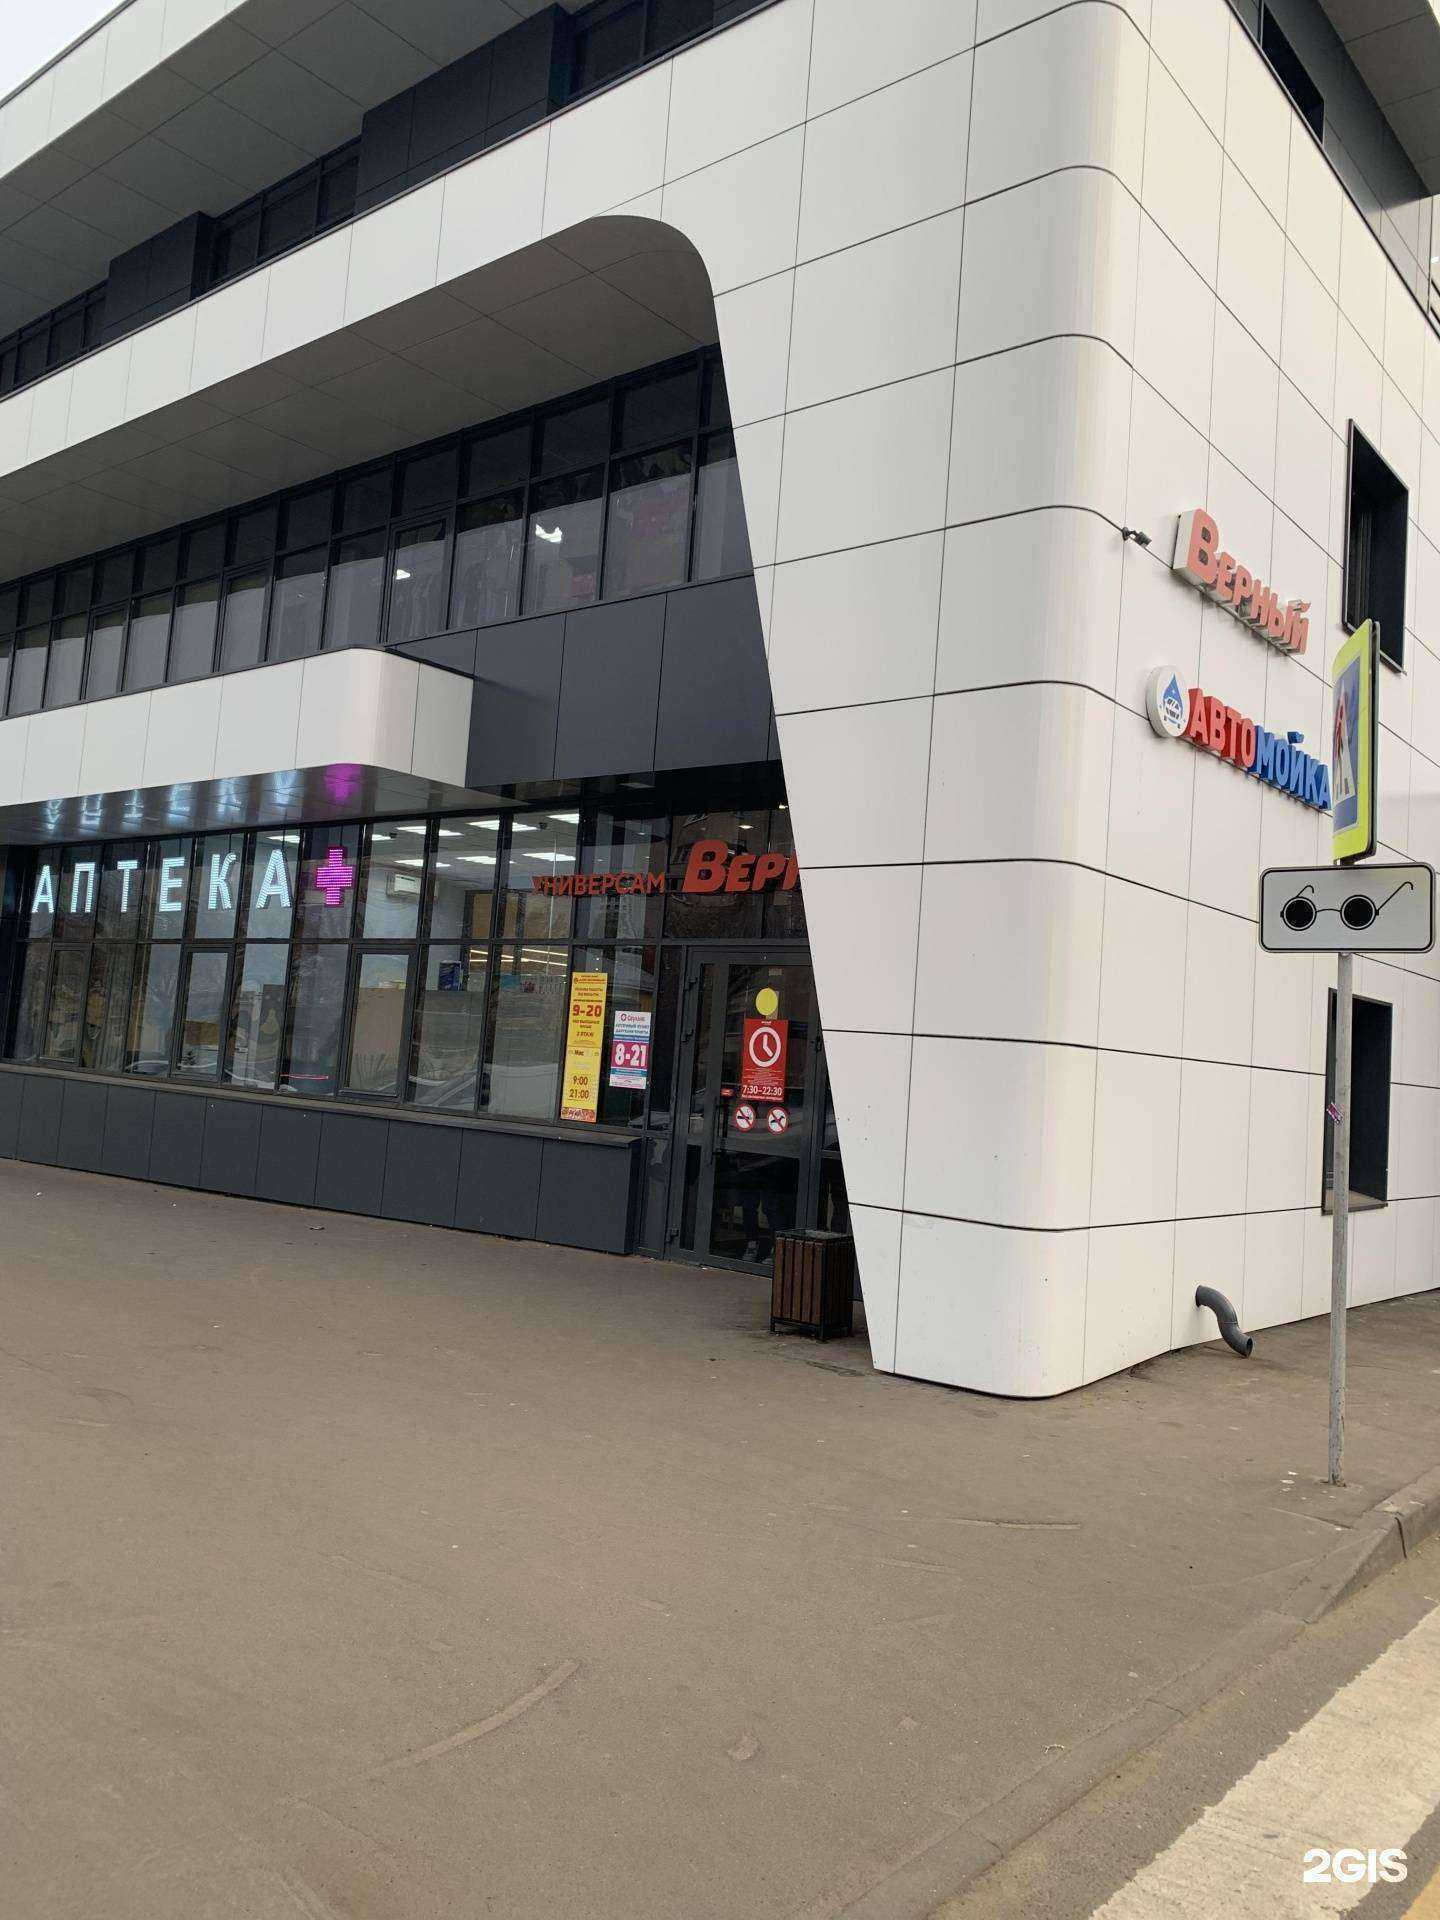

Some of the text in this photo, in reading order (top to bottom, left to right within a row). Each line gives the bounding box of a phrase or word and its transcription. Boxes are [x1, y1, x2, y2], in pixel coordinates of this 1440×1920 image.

[1187, 687, 1333, 811] АВТОМОЙКА
[31, 849, 291, 914] АПТЕКА
[531, 871, 666, 897] УНИВЕРСАМ
[572, 1004, 602, 1018] 9-20
[615, 1043, 647, 1067] 8-21
[573, 1075, 589, 1086] 9:00
[569, 1088, 590, 1100] 21:00
